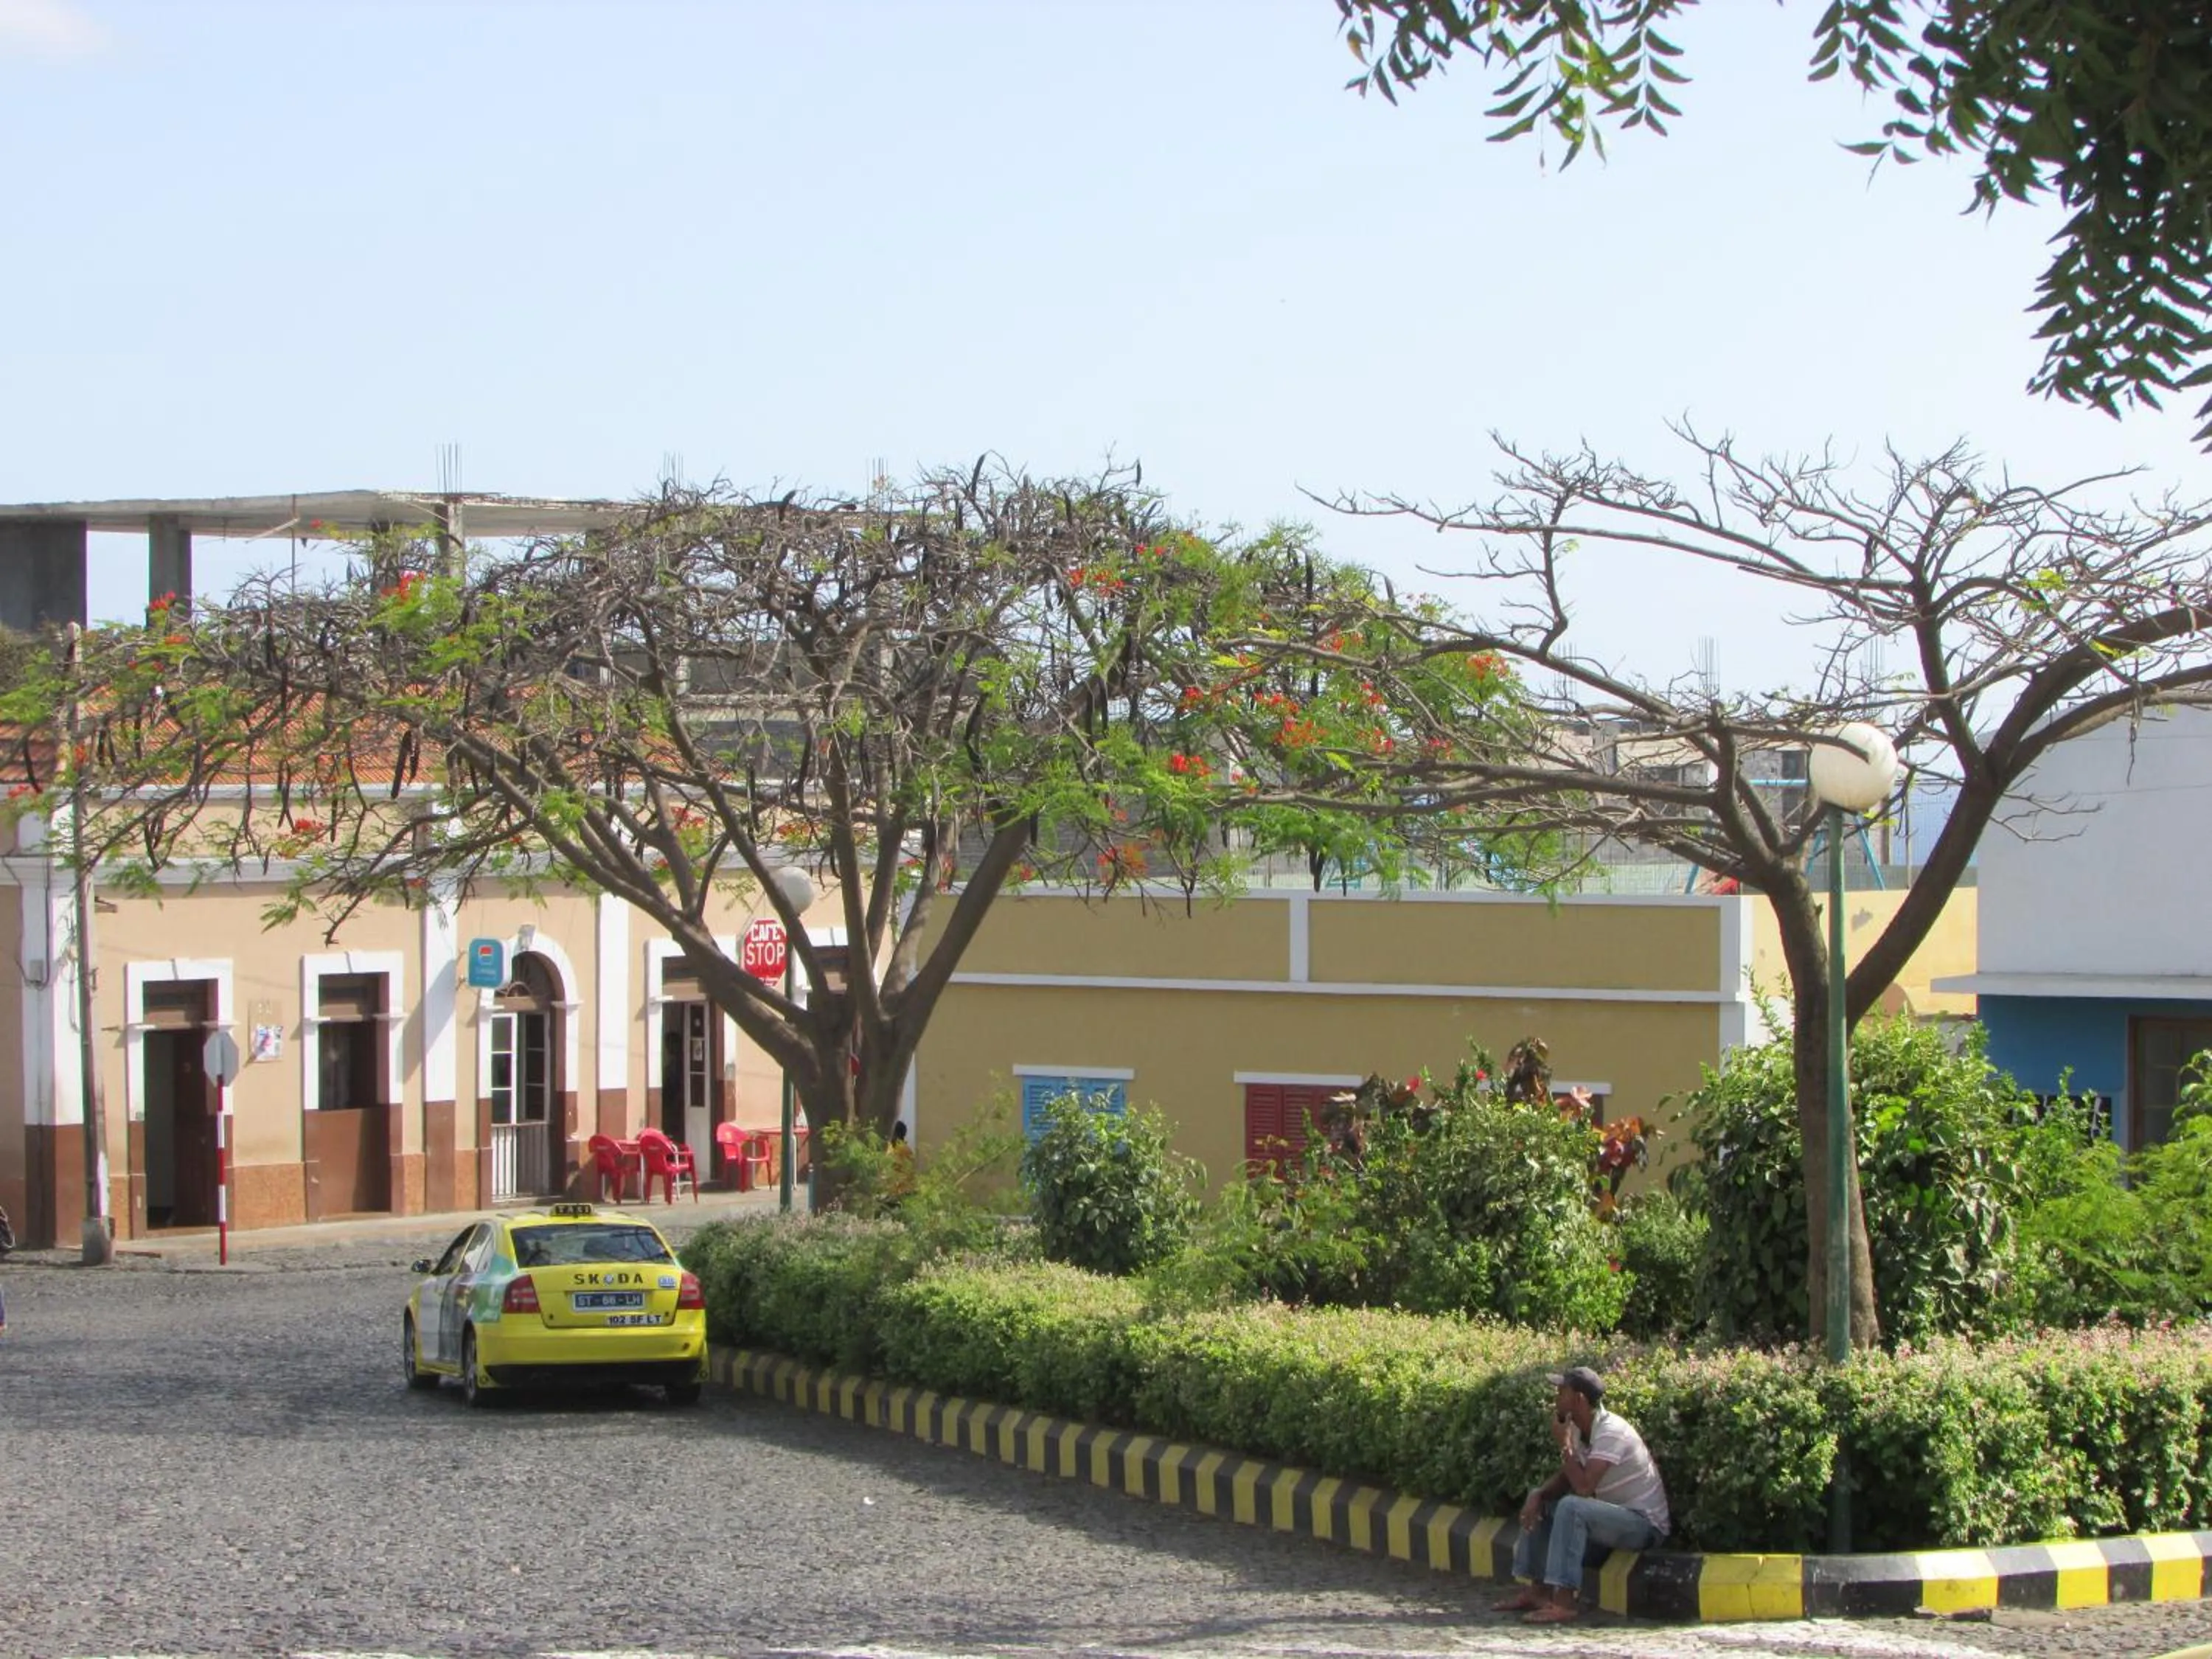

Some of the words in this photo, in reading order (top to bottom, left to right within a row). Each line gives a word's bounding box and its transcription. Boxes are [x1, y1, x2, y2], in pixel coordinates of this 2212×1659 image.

[746, 942, 785, 965] STOP
[557, 1205, 589, 1214] TAXI
[574, 1273, 643, 1285] SKODA
